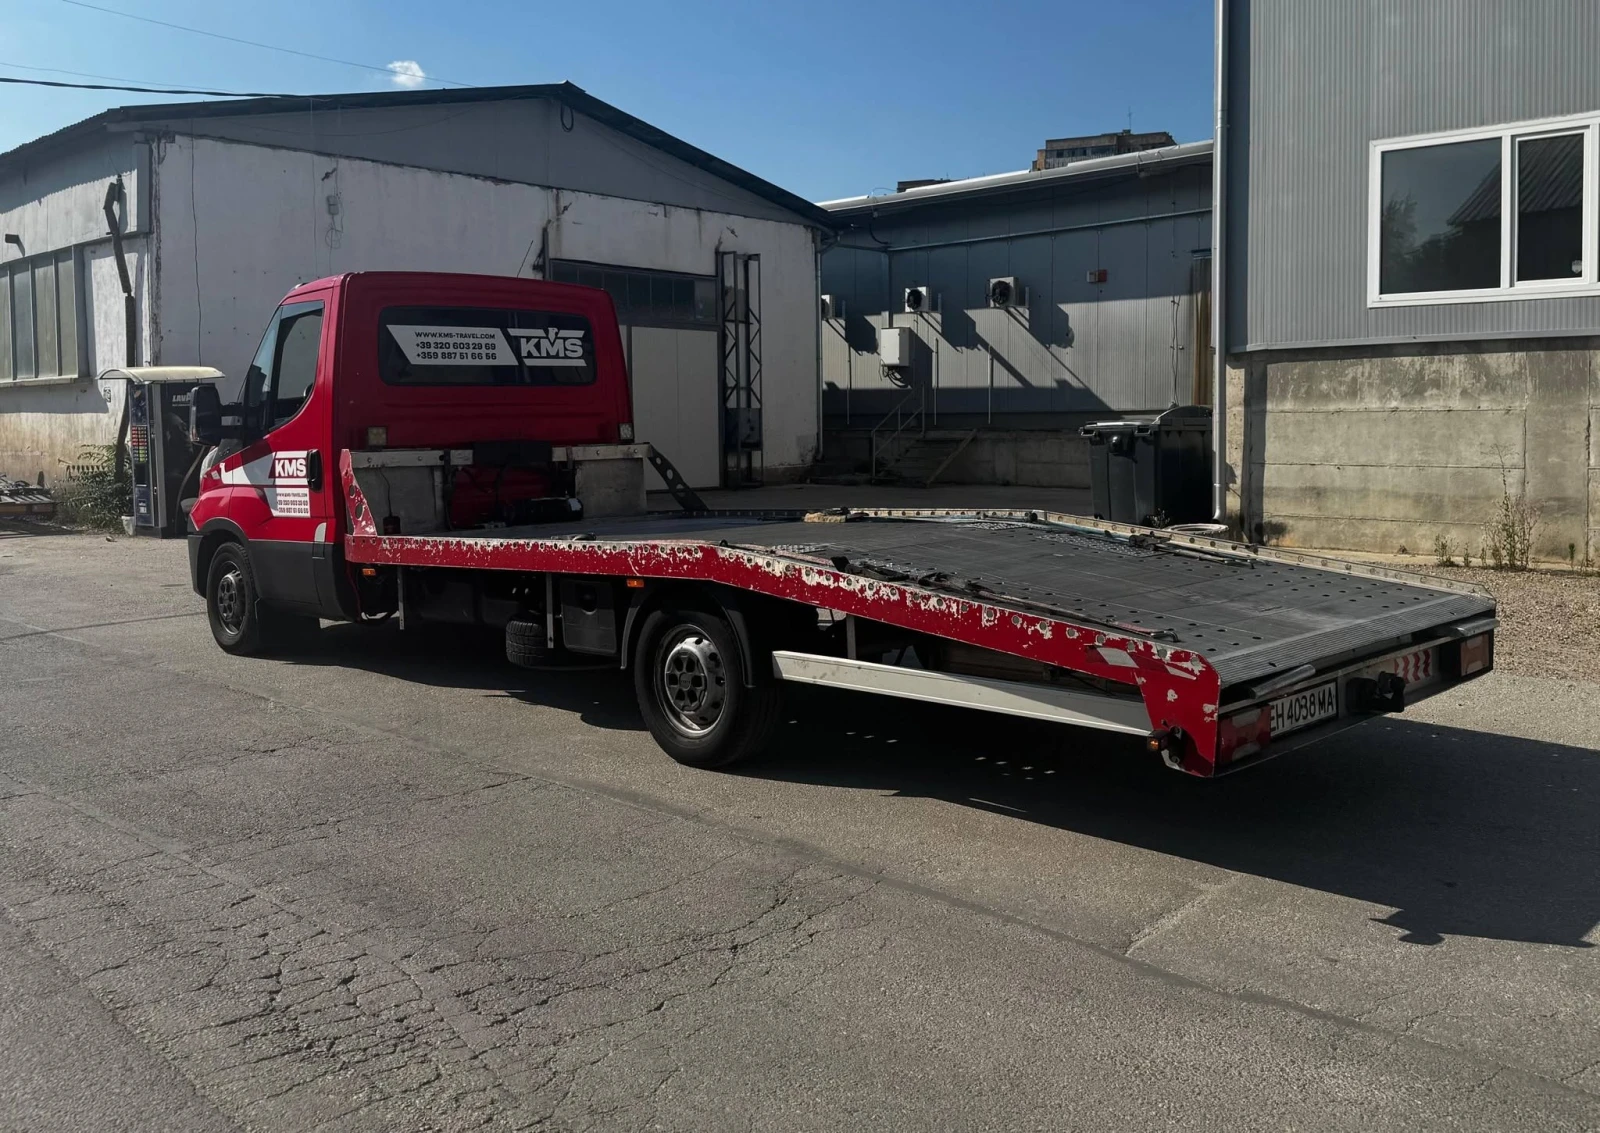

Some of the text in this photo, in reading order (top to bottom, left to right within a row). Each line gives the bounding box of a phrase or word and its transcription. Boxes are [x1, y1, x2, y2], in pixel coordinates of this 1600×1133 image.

[414, 331, 496, 339] WWW.KMS-TRAVEL.COM
[415, 341, 496, 350] +39 320 603 29 69
[520, 337, 584, 358] KMS
[416, 351, 497, 360] +359 887 51 66 56
[275, 458, 307, 477] KMS
[1286, 692, 1316, 725] 4038
[1318, 687, 1334, 715] MA
